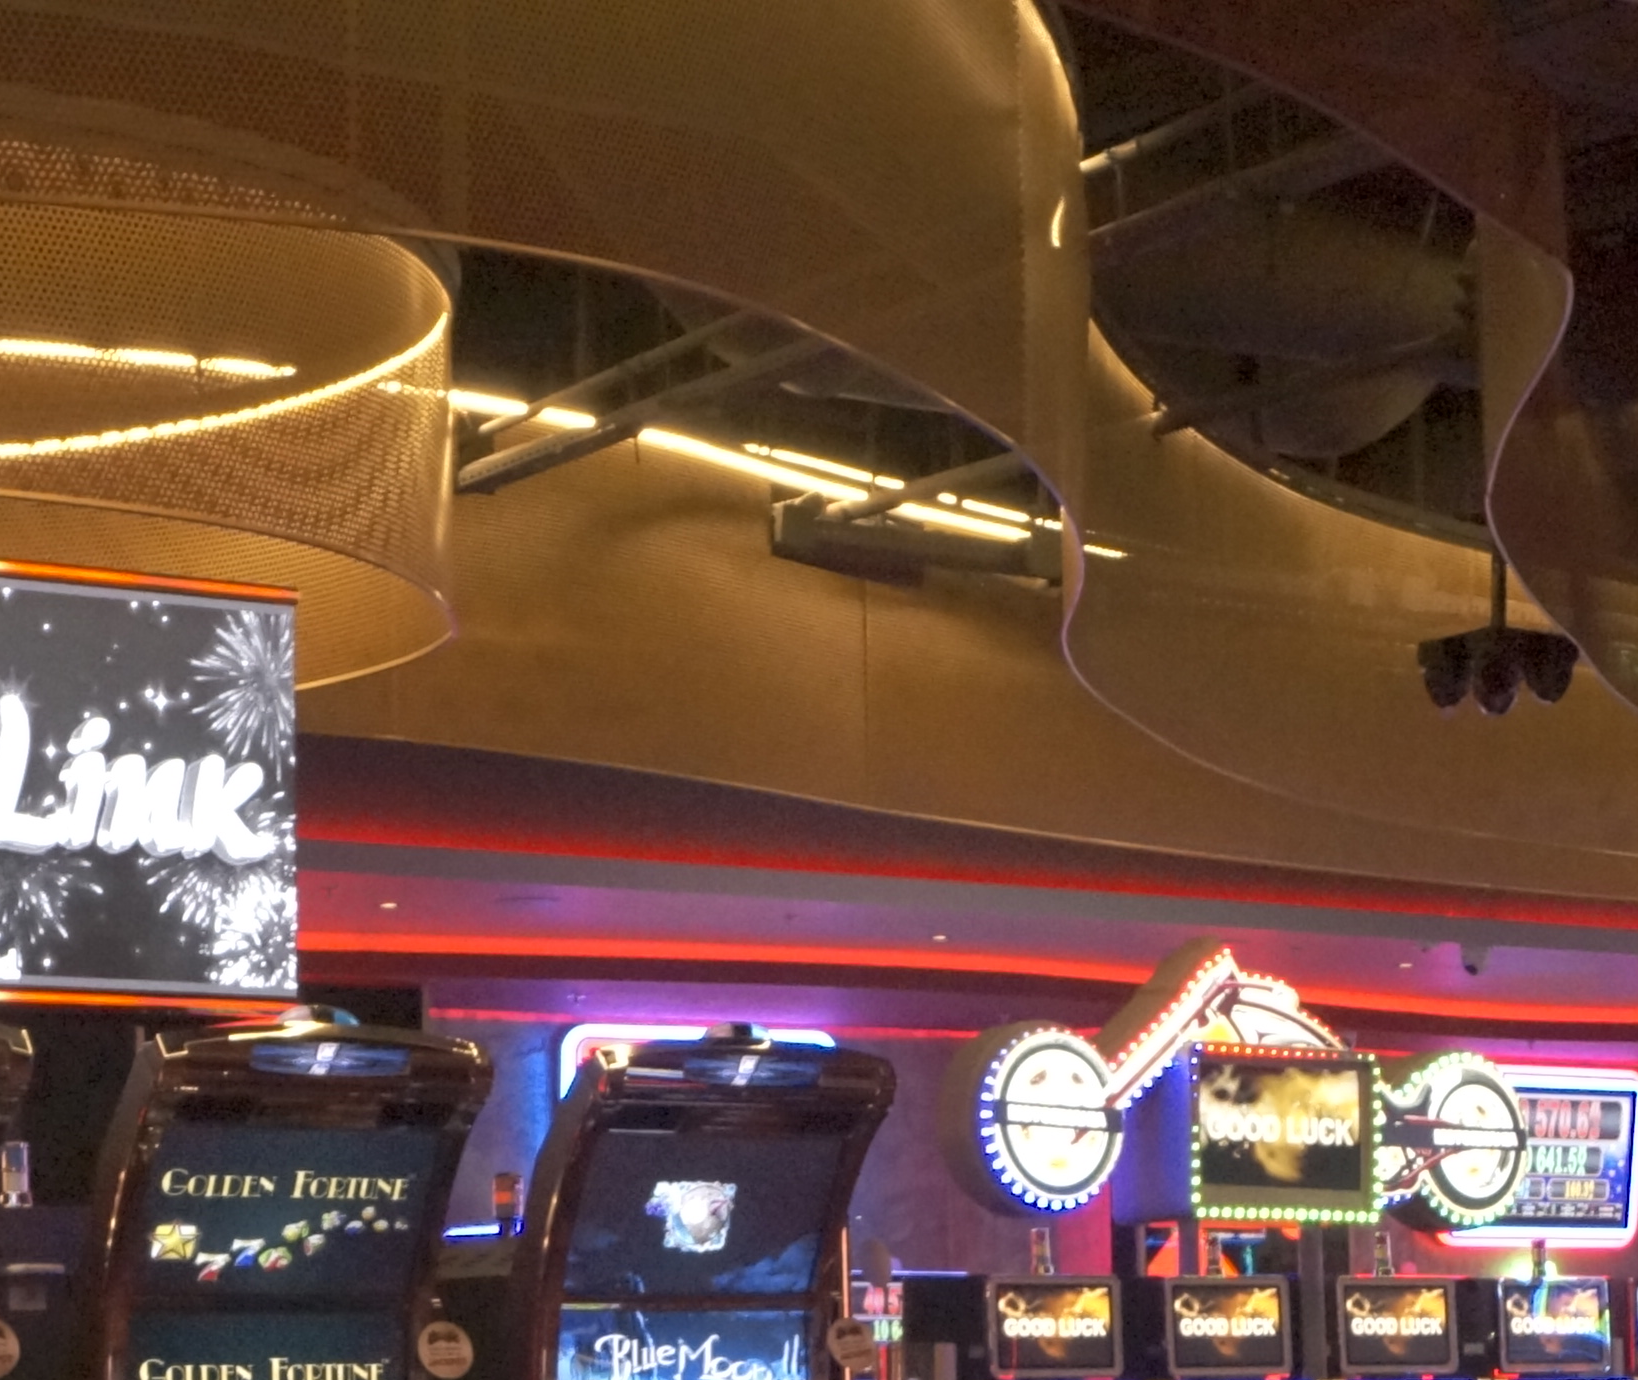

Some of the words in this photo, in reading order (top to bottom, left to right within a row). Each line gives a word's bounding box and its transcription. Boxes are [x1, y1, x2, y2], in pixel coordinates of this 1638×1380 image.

[1206, 1113, 1281, 1143] GOOD
[1286, 1117, 1354, 1147] LUCK
[161, 1168, 277, 1198] GOLDEN
[290, 1170, 410, 1200] FORTUNE
[1003, 1317, 1056, 1337] GOOD
[1059, 1317, 1107, 1336] LUCK
[1179, 1317, 1229, 1337] GOOD
[1231, 1317, 1276, 1336] LUCK
[1351, 1317, 1397, 1337] GOOD
[1400, 1317, 1443, 1336] LUCK
